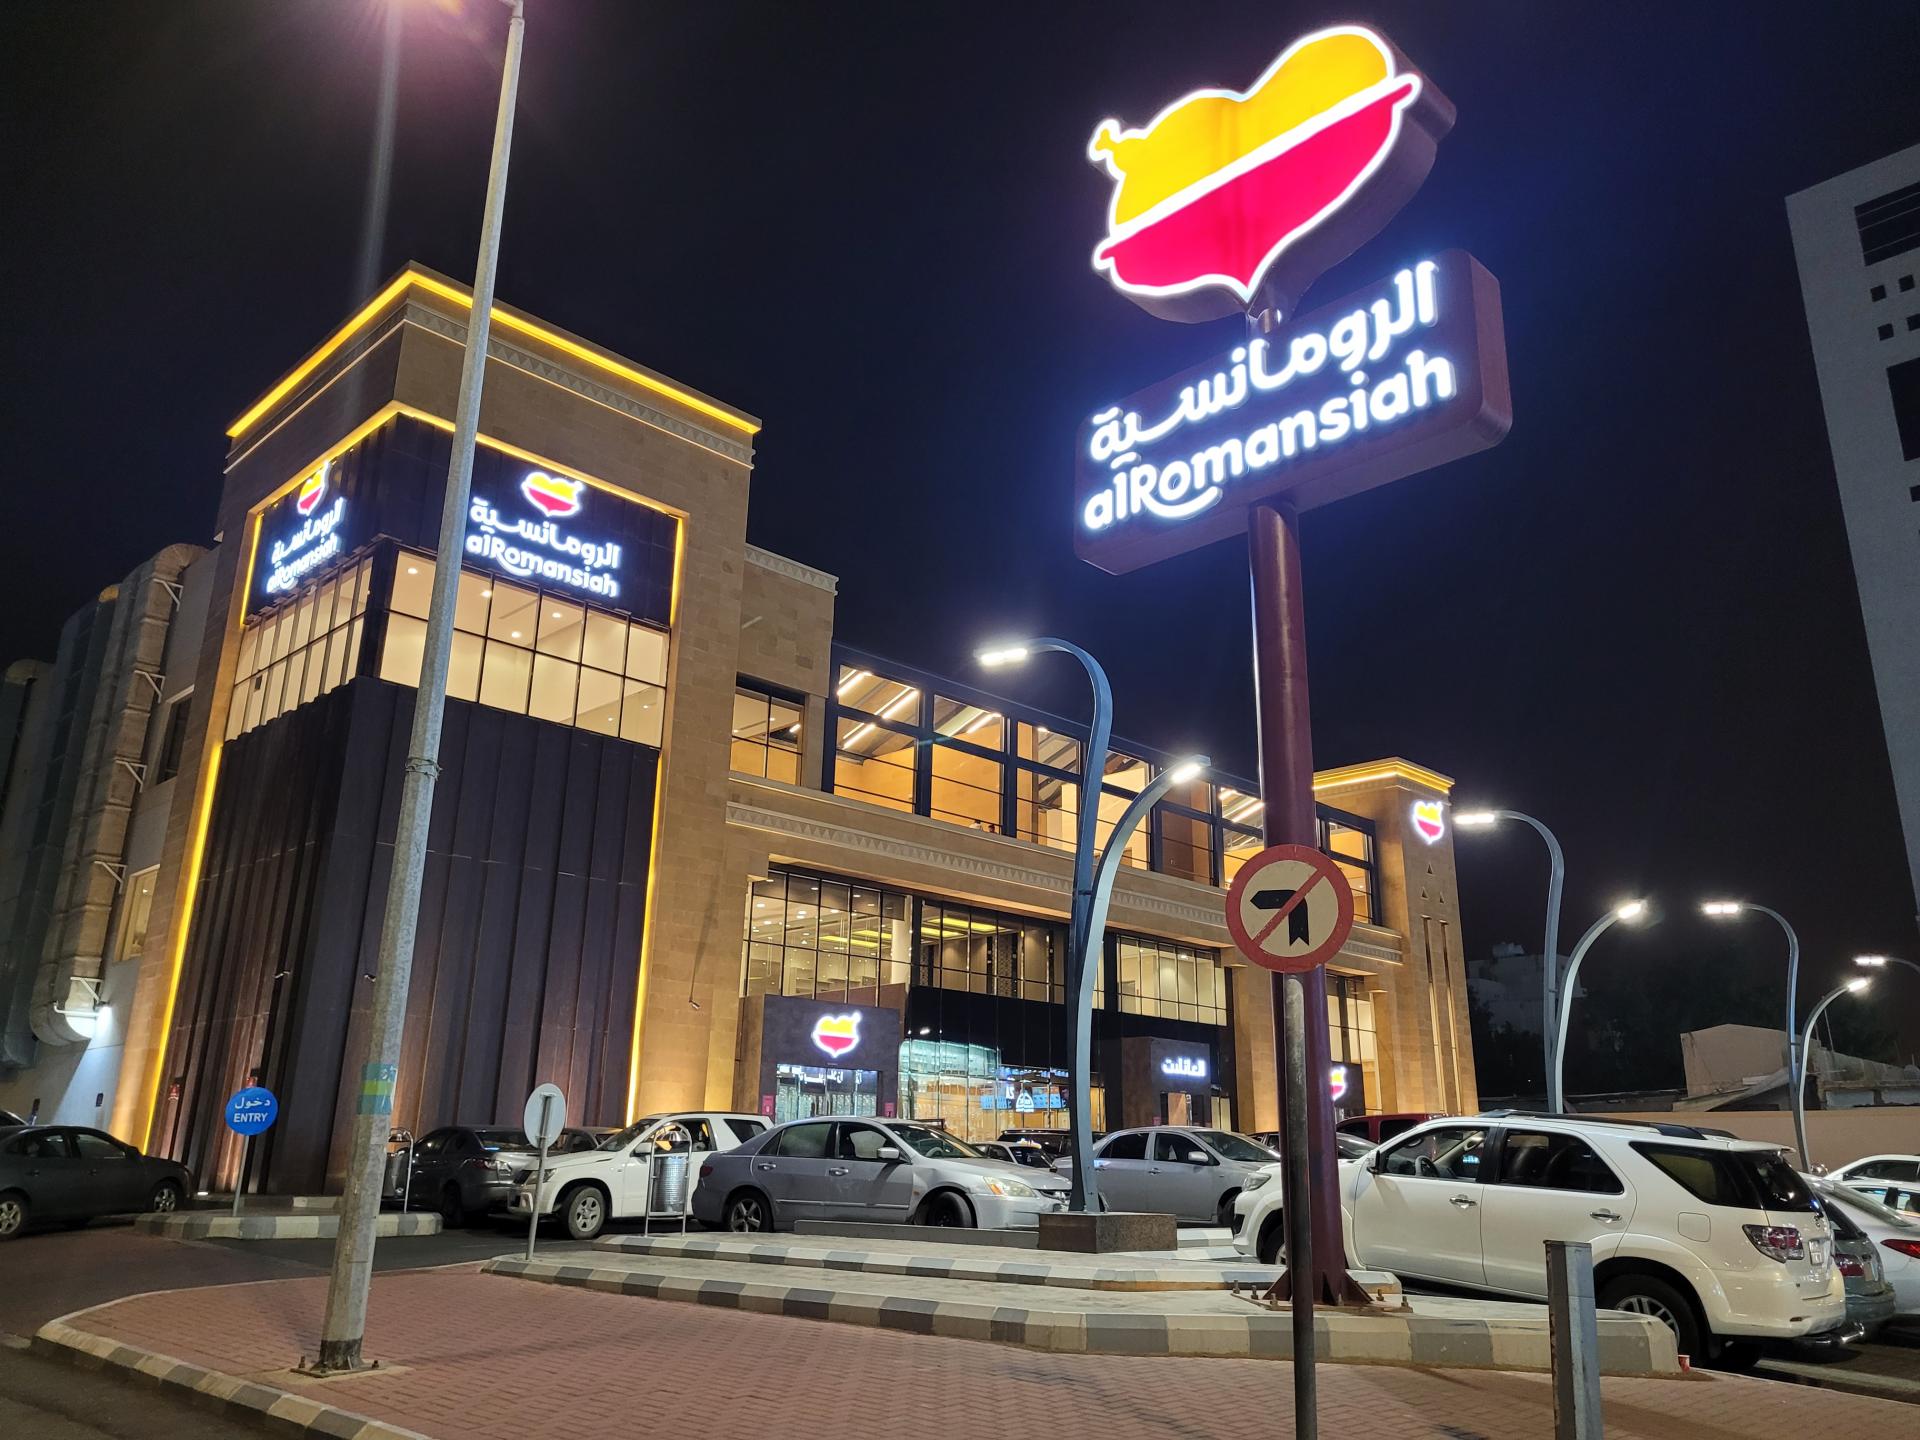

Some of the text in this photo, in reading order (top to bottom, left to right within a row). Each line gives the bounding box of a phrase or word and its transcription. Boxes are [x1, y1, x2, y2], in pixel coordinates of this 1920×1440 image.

[1089, 260, 1440, 469] الرومانسية
[1083, 348, 1455, 530] alRomansiah
[465, 534, 619, 597] alRomansiah
[470, 497, 621, 568] الرومانسية
[233, 1112, 268, 1123] ENTRY
[234, 1097, 271, 1109] دخول
